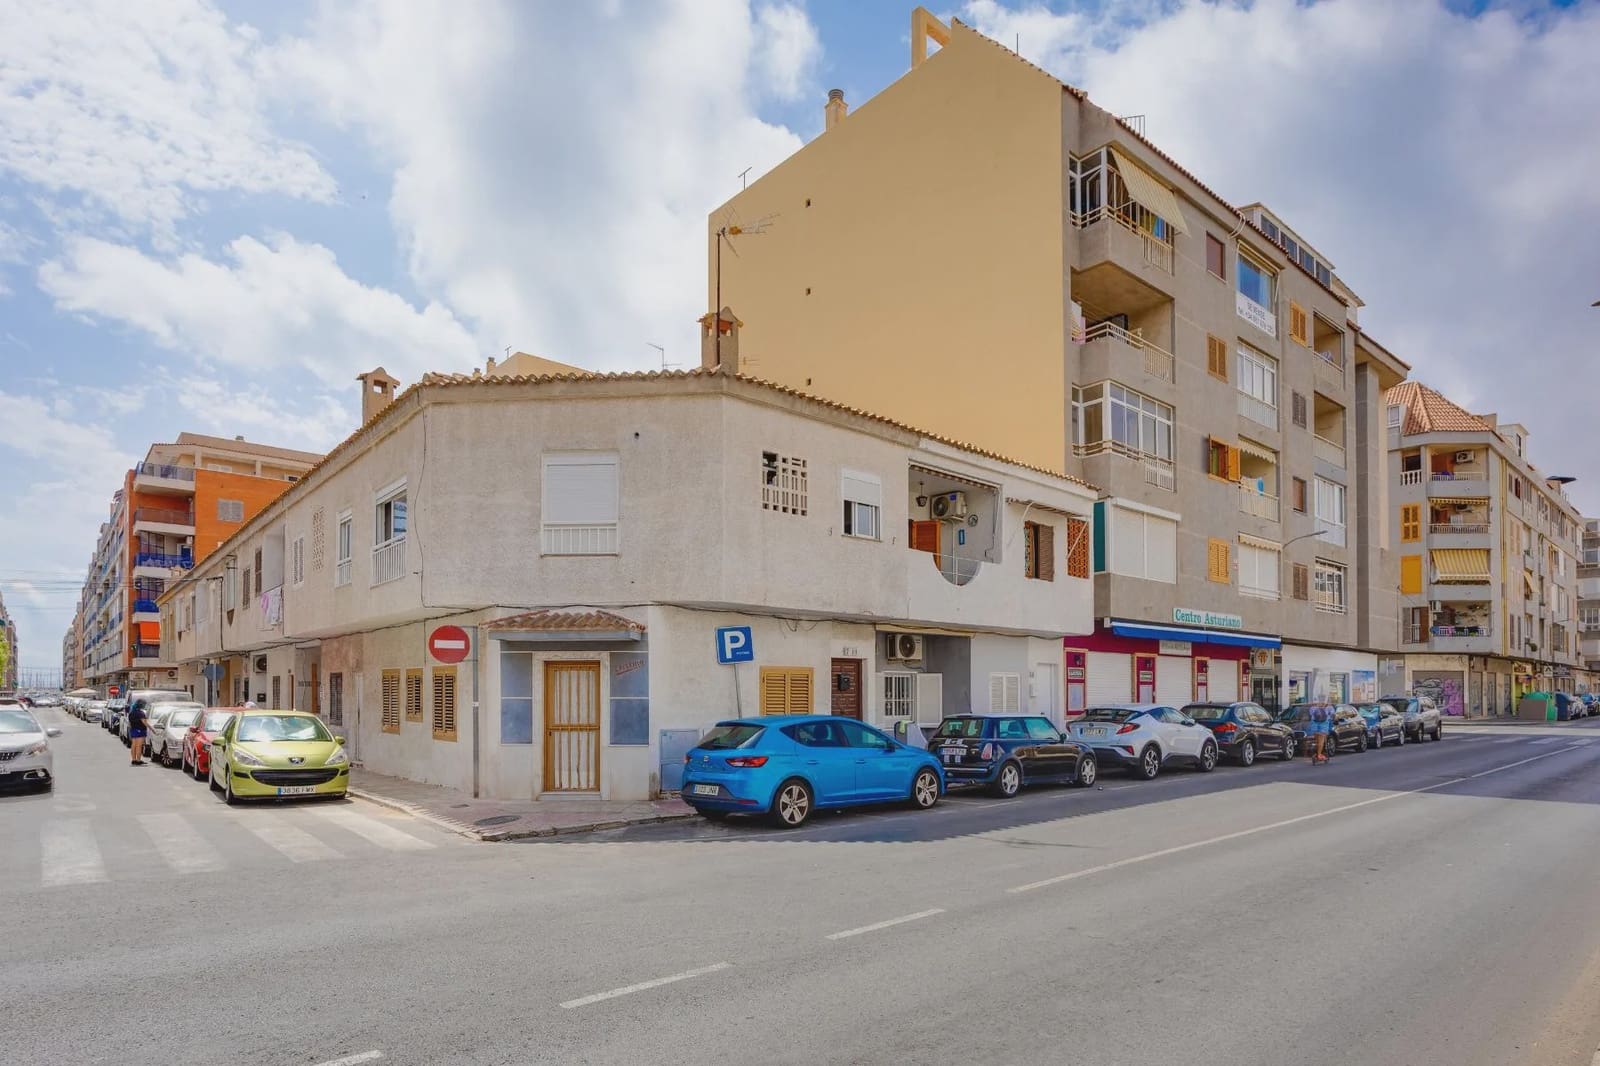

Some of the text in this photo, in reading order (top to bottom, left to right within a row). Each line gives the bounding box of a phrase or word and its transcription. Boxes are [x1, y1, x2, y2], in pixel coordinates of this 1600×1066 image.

[1175, 608, 1241, 628] Centro Asturiano
[724, 631, 745, 658] P
